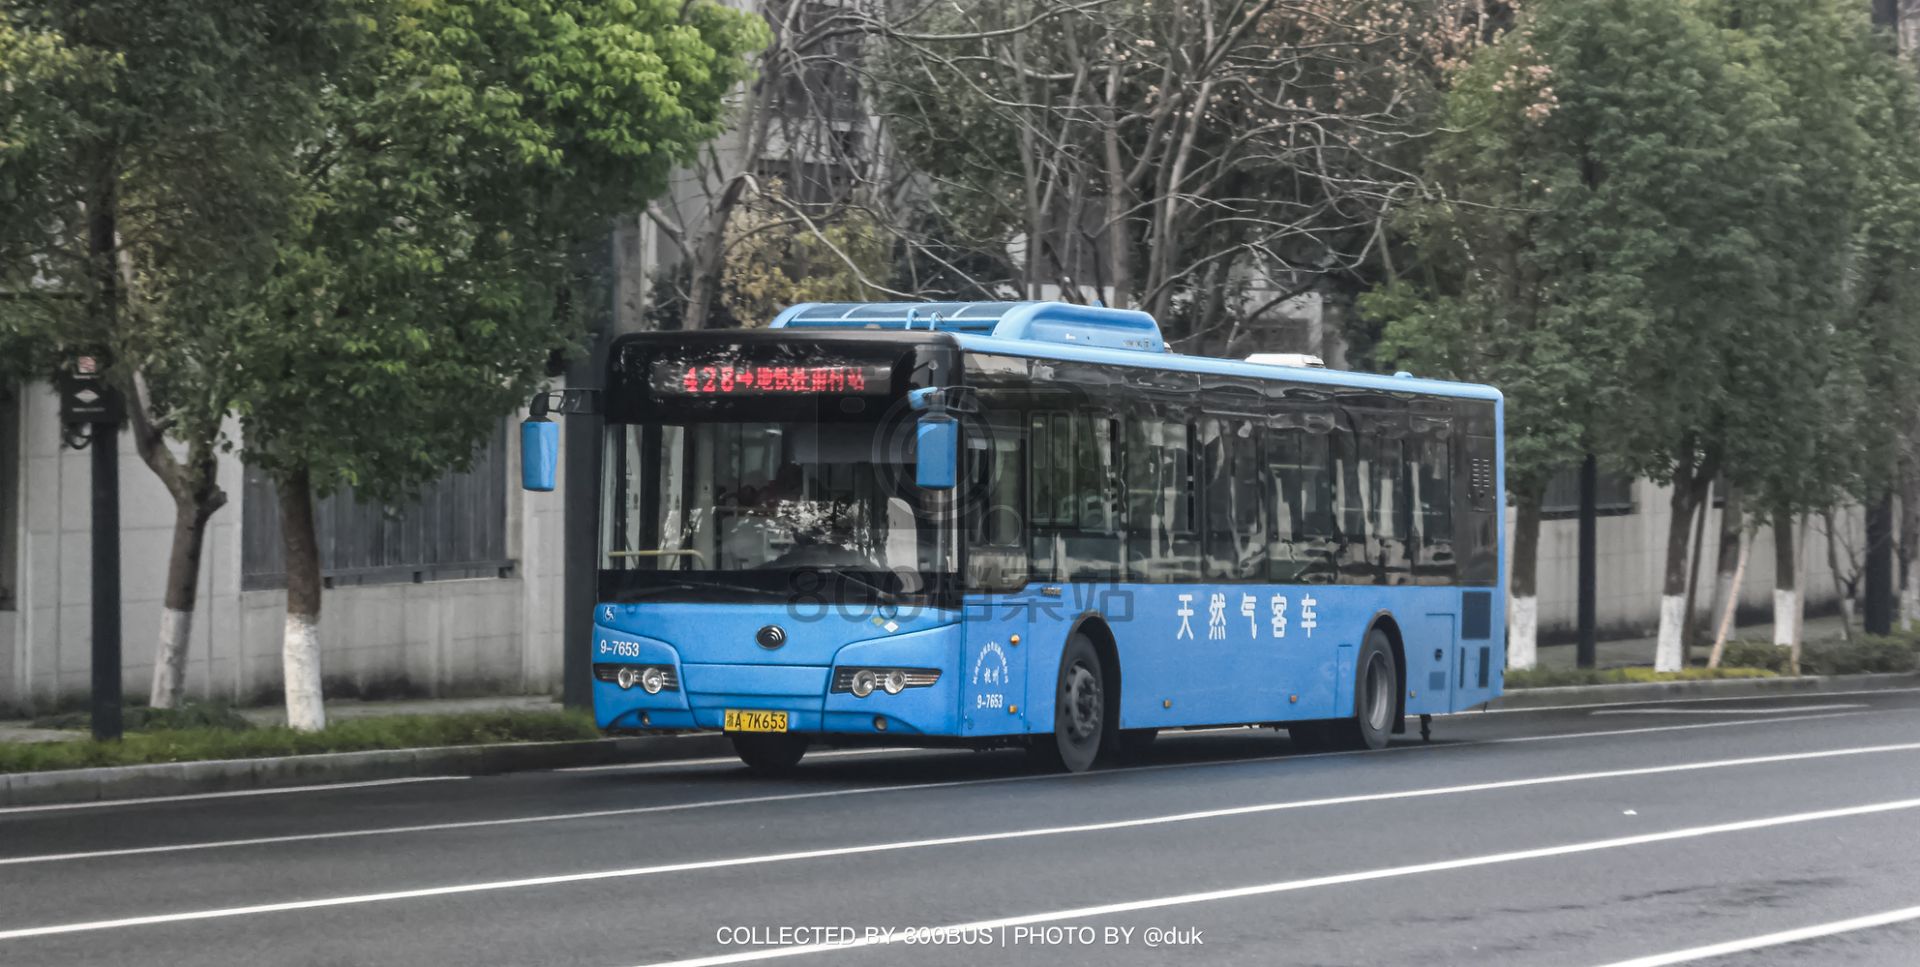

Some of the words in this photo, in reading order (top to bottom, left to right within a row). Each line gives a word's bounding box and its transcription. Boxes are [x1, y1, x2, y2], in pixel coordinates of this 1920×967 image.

[1177, 593, 1317, 639] 天然气客车
[600, 639, 639, 657] 9-7653
[977, 694, 1003, 708] 9-7653
